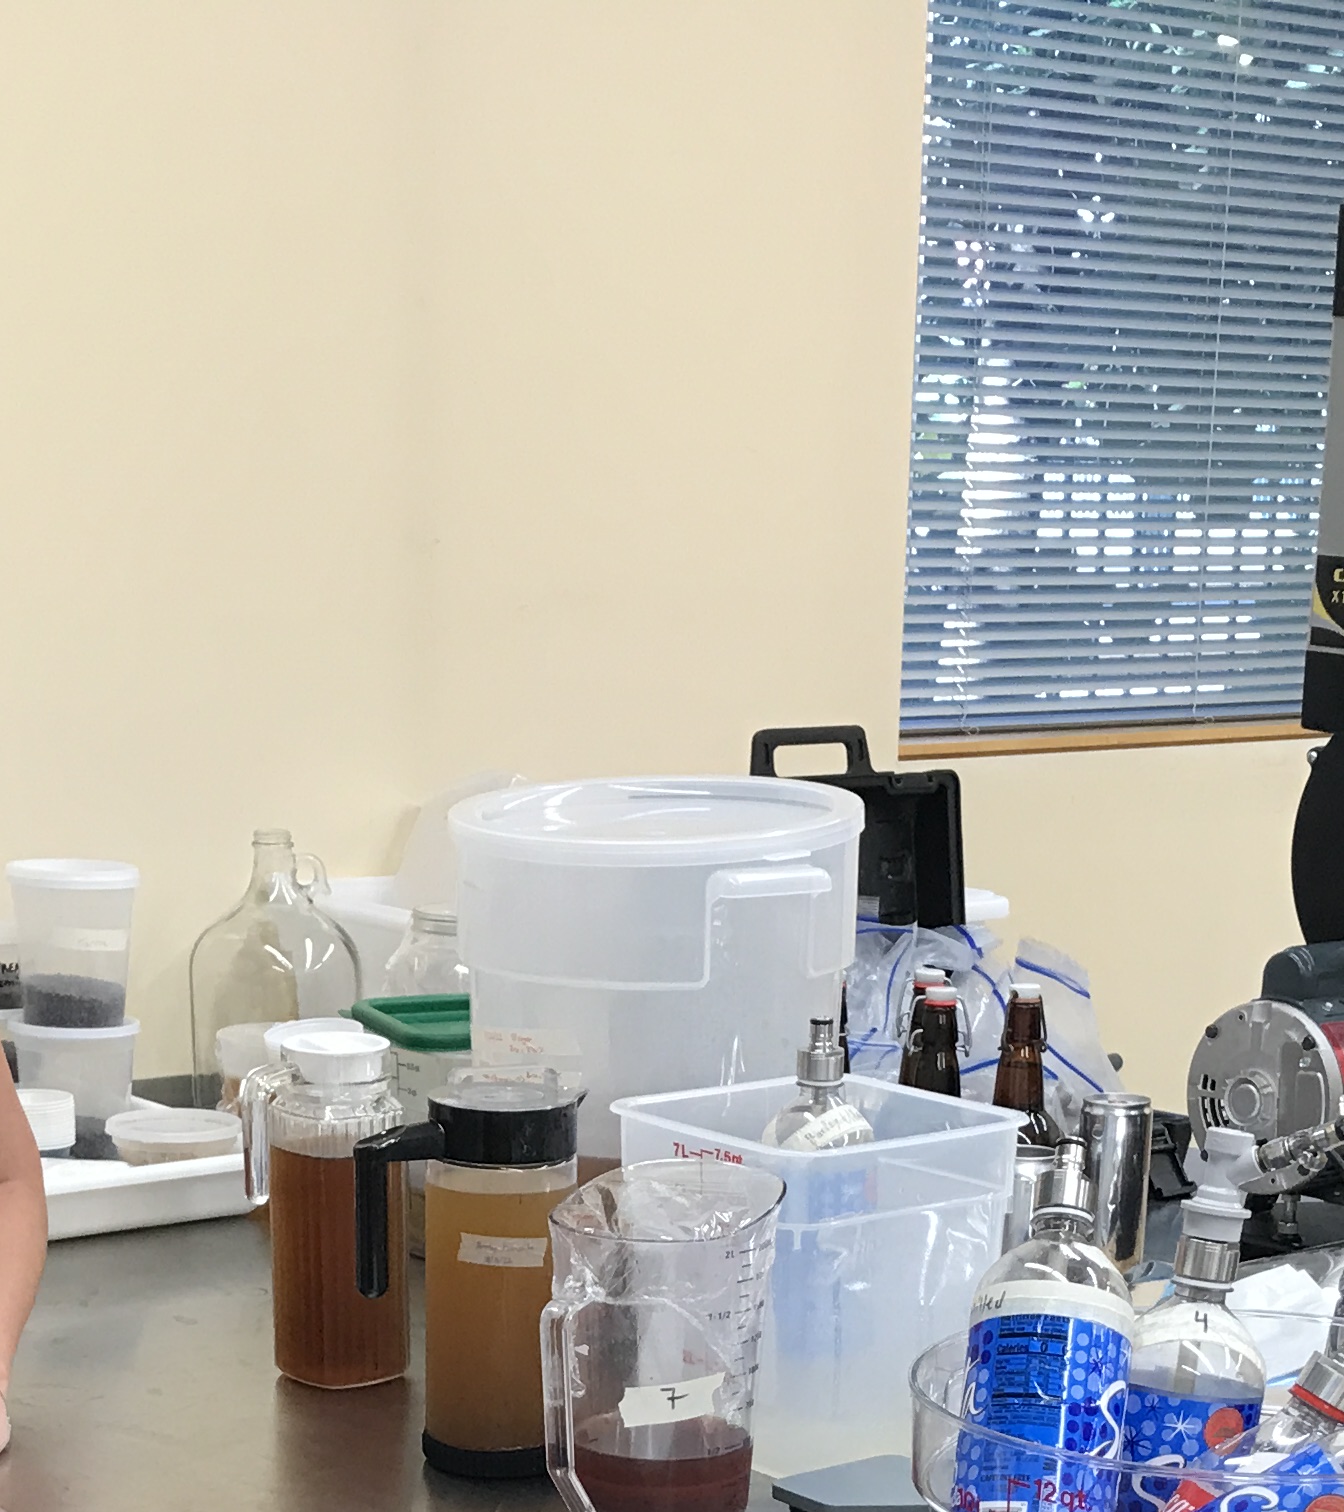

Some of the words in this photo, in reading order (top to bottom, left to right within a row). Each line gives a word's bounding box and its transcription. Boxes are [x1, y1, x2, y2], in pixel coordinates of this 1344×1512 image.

[1331, 590, 1341, 603] X
[673, 1143, 689, 1158] 7L
[1193, 1310, 1209, 1334] 4
[660, 1387, 689, 1409] 7
